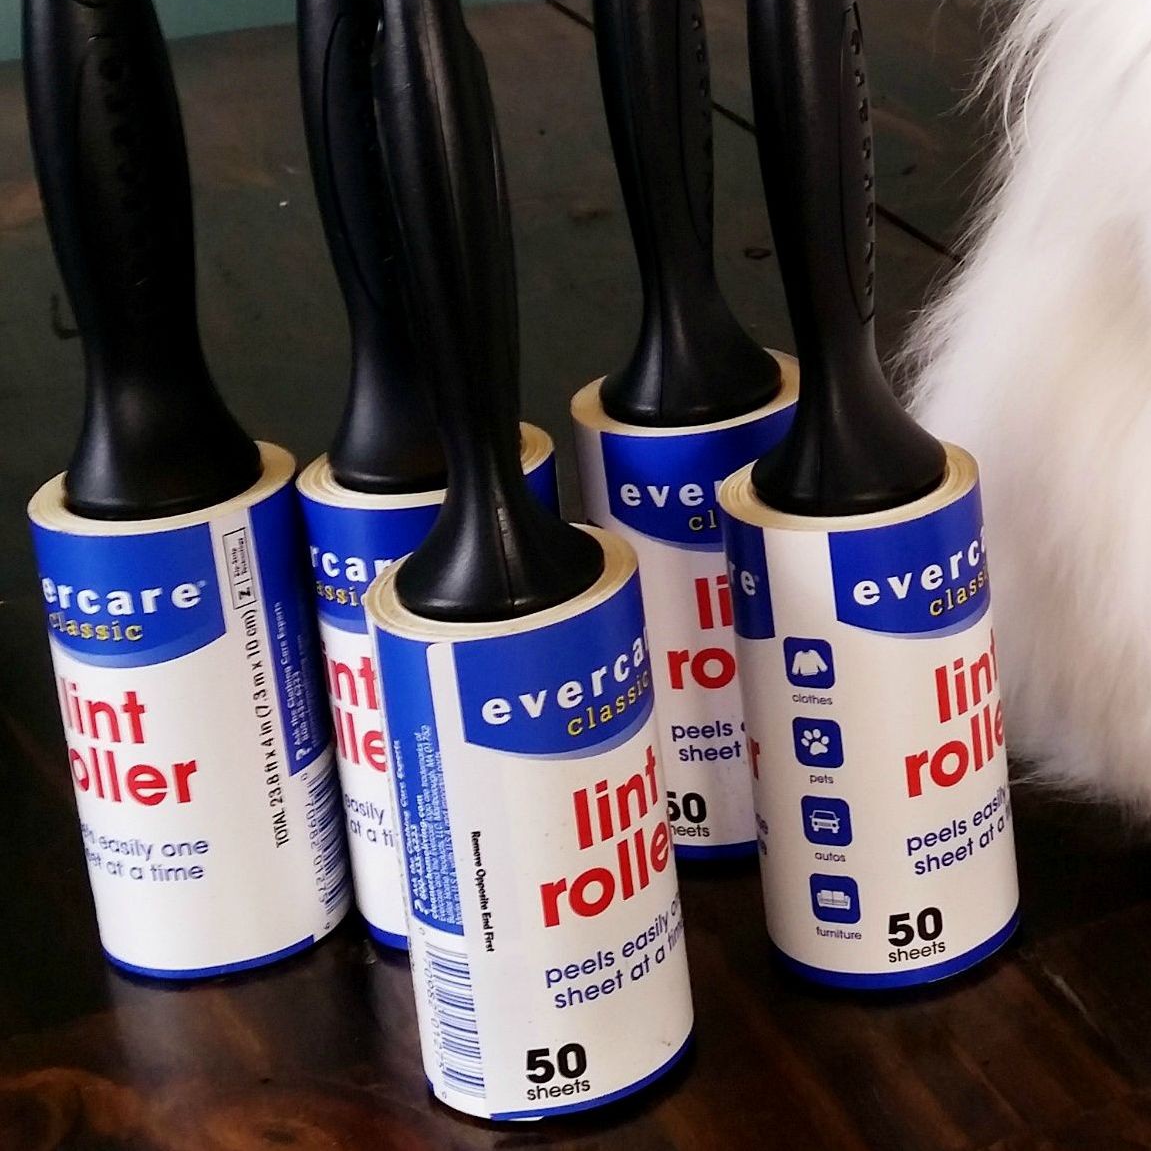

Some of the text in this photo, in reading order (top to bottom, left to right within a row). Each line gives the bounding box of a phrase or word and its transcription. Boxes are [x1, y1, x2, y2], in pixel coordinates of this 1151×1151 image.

[58, 678, 147, 744] lint
[792, 693, 833, 706] clothes
[241, 609, 290, 848] TOTAL 23.8 ft x 4 in (7.3 m x 10 cm)
[671, 721, 733, 742] peels
[679, 741, 741, 762] sheet
[809, 774, 834, 785] pets
[572, 745, 658, 850] lint
[99, 836, 153, 862] easily
[162, 840, 209, 857] one
[907, 819, 968, 856] peels
[914, 816, 1005, 875] sheet at a
[106, 860, 204, 881] at a time
[814, 851, 847, 863] autos
[470, 831, 495, 952] Remove Opposite End First
[816, 926, 862, 940] furniture
[888, 907, 943, 947] 50
[545, 911, 668, 989] peels easily
[888, 940, 946, 963] sheets
[554, 970, 623, 1009] sheet
[630, 954, 650, 981] at
[655, 945, 665, 964] a
[525, 1043, 587, 1084] 50
[526, 1079, 591, 1101] sheets
